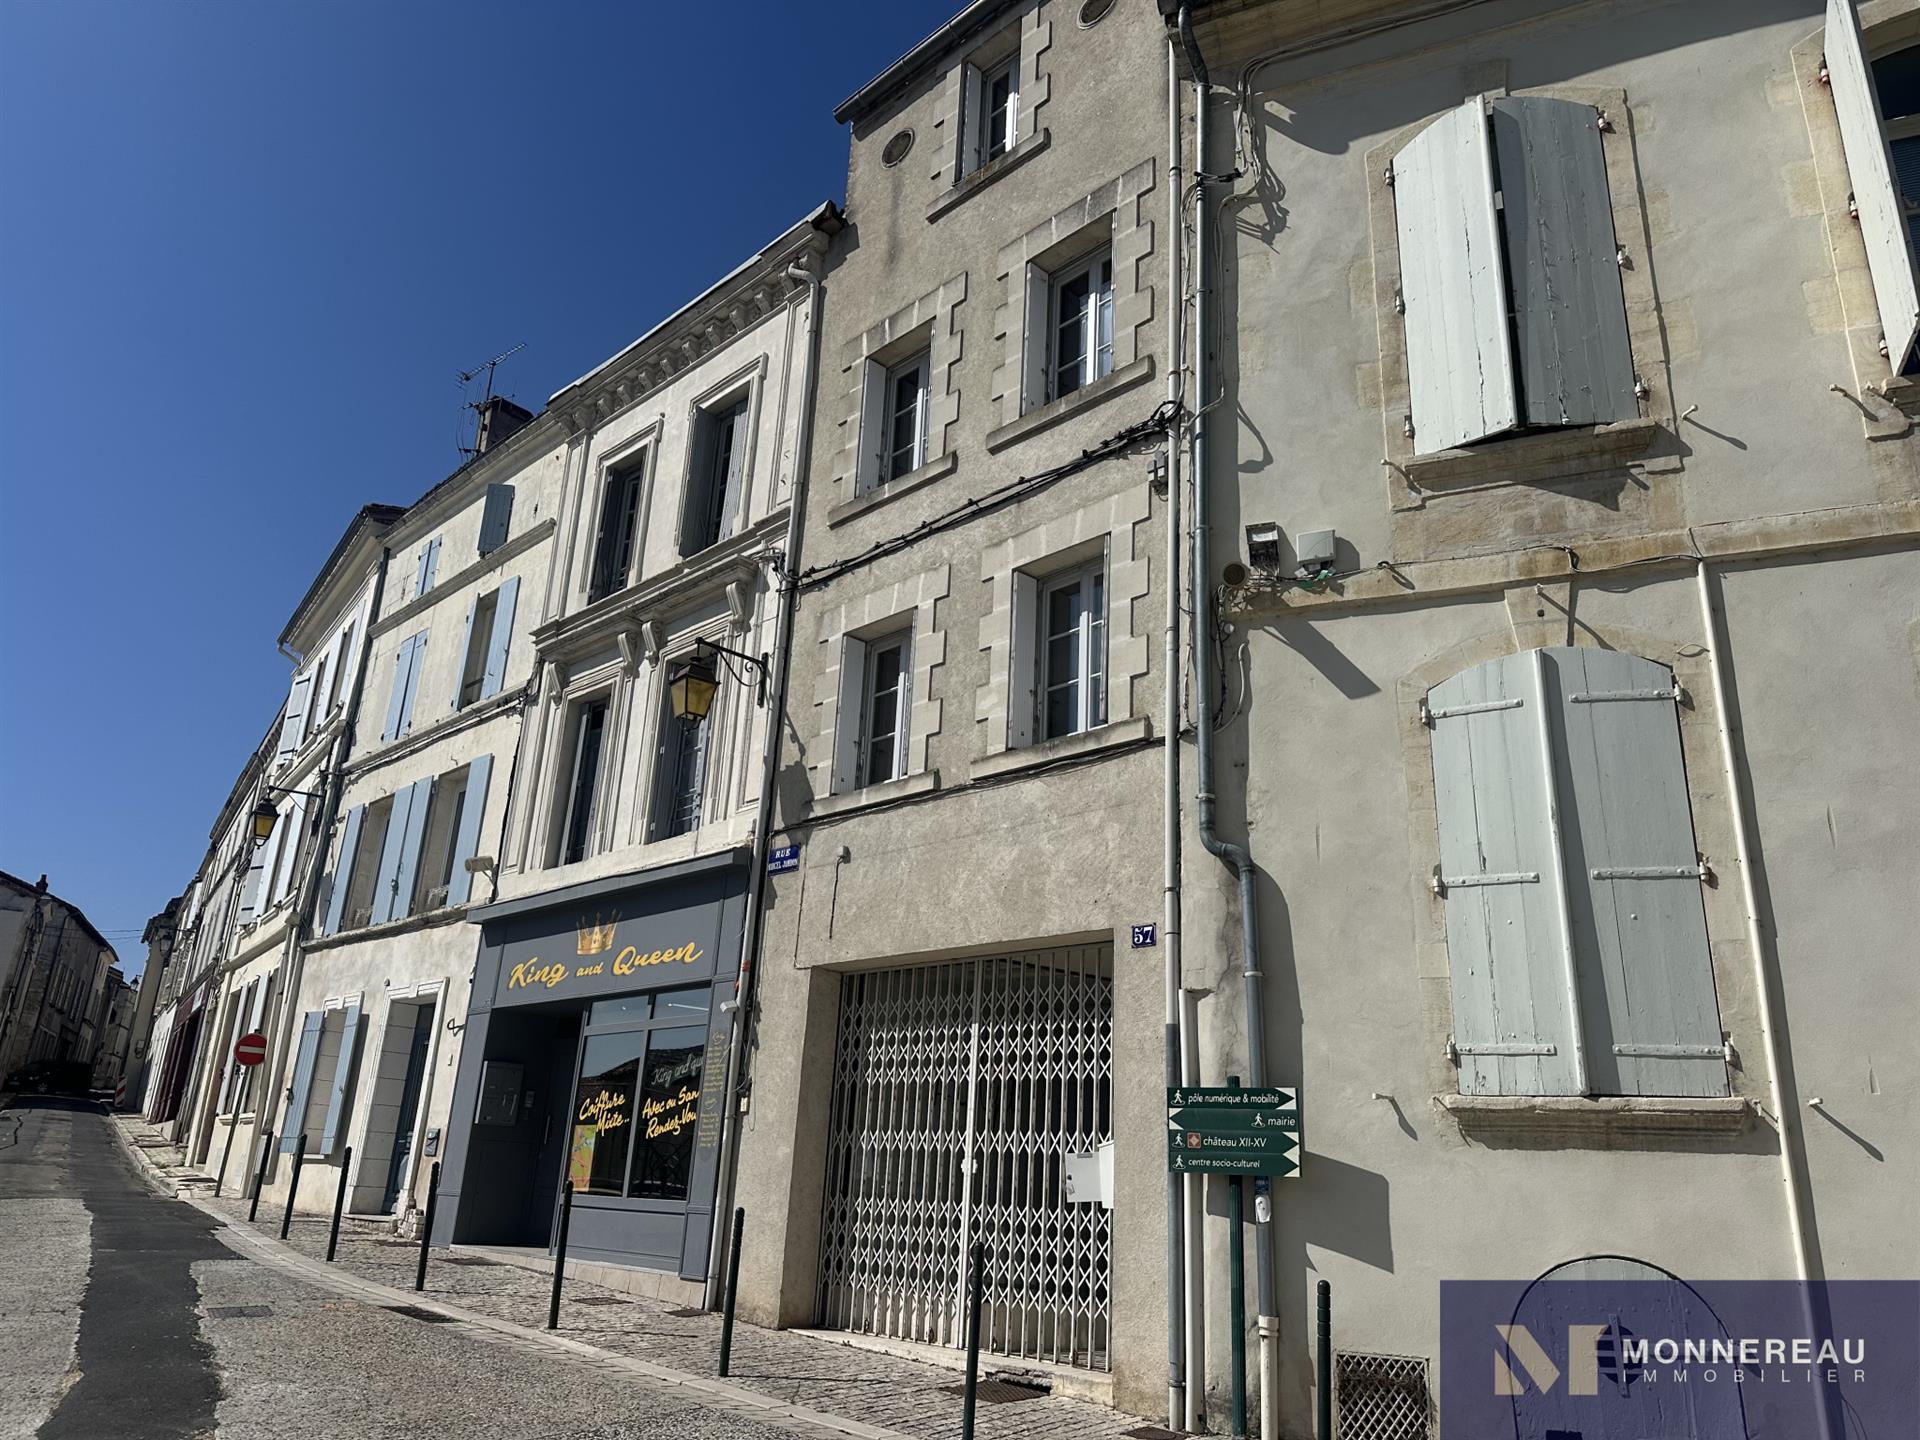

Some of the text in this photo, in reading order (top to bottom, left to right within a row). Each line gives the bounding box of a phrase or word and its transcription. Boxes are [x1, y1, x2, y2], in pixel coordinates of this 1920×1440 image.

[775, 848, 791, 859] RUE
[1134, 926, 1153, 944] 57
[508, 941, 703, 990] King and Queen
[579, 1089, 625, 1120] Coiffure
[1188, 1093, 1280, 1104] pôle numérique & mobilité
[642, 1097, 665, 1119] Avec
[666, 1098, 677, 1110] ou
[1267, 1117, 1296, 1126] mairie
[1203, 1136, 1267, 1148] château XII-XV
[1188, 1158, 1261, 1169] centre socio-culturel
